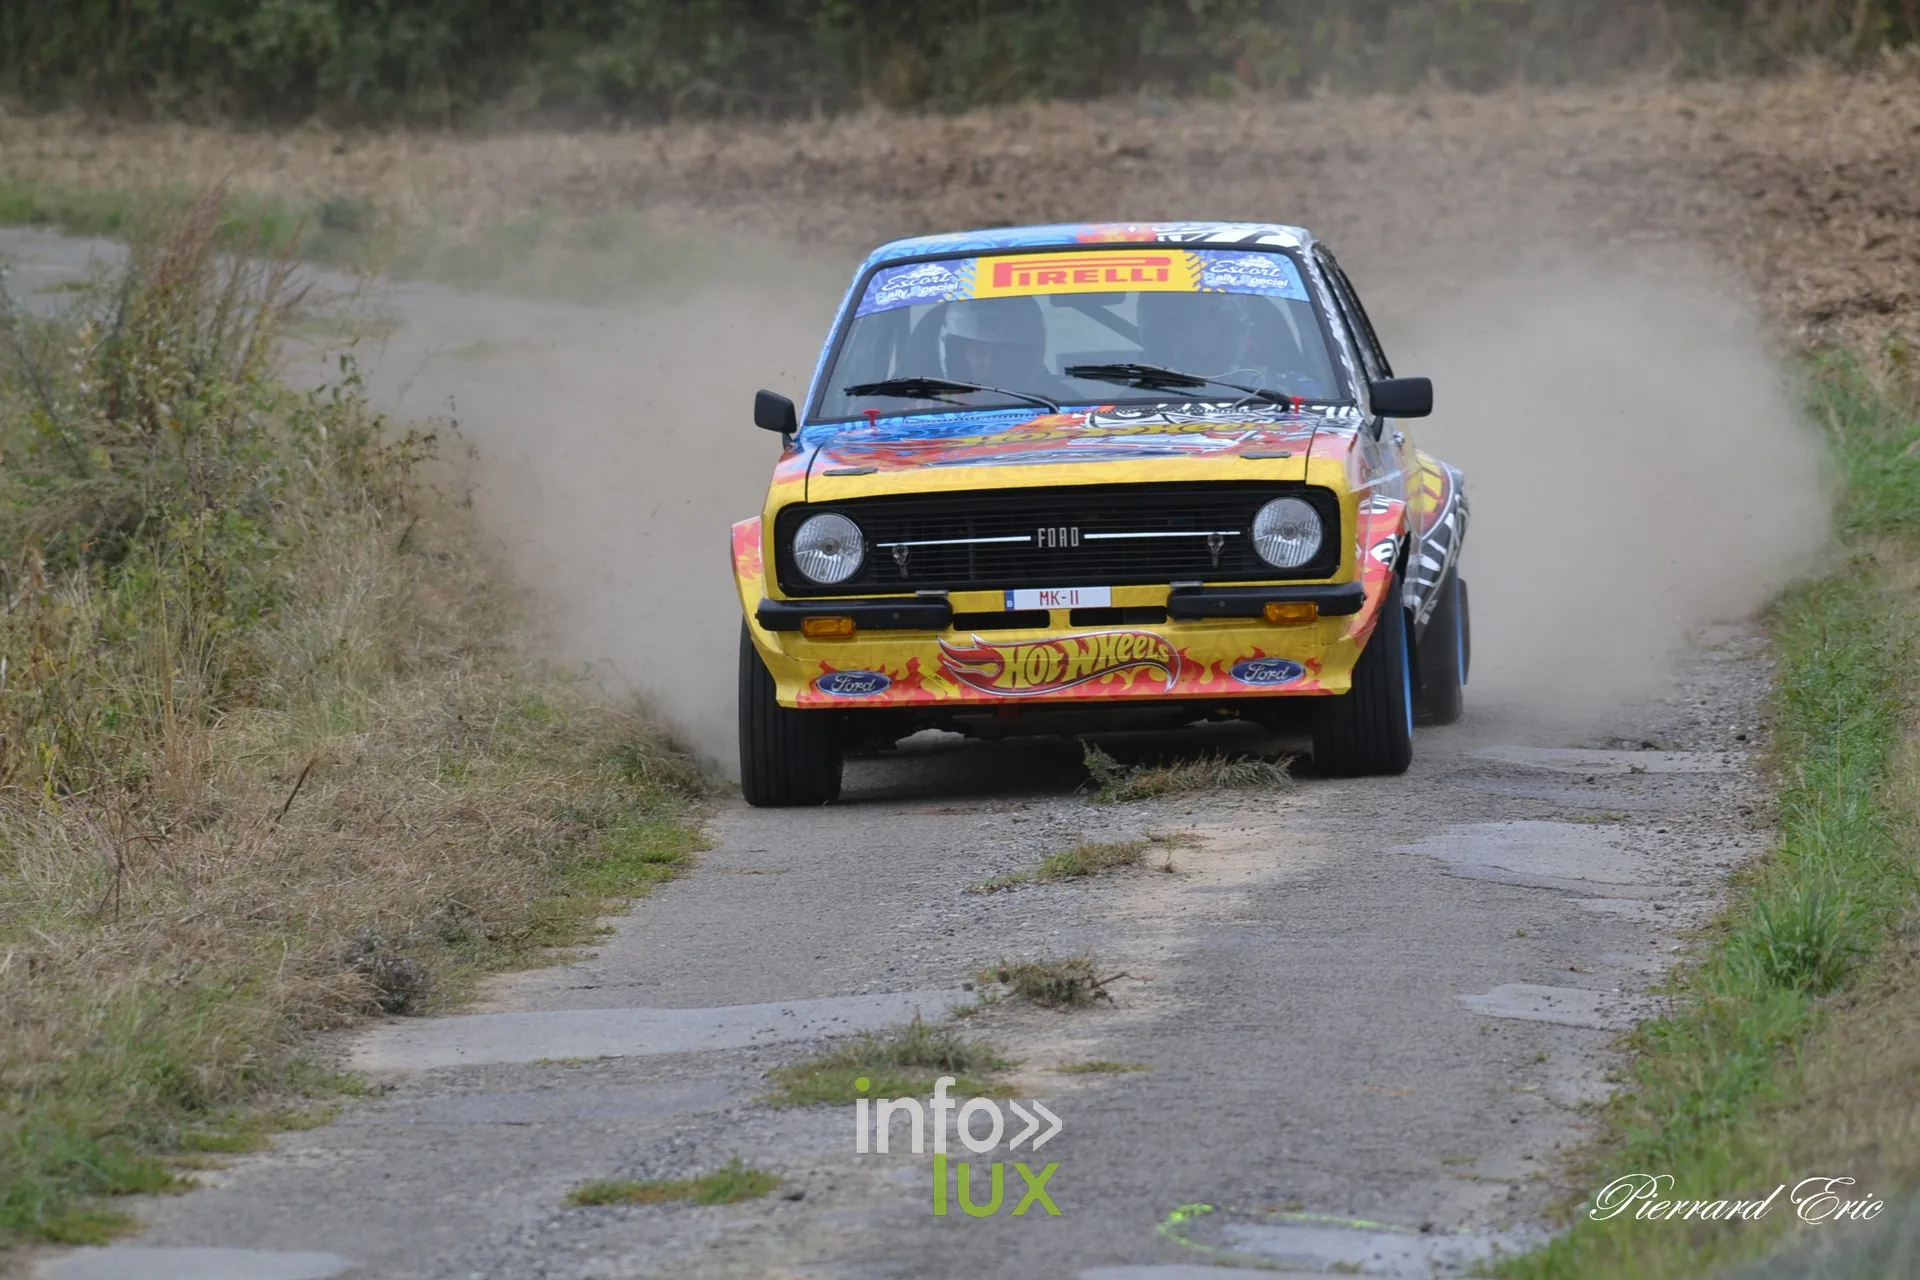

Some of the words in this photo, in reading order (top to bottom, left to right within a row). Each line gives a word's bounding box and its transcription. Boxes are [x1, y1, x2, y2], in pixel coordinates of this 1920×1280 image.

[993, 257, 1172, 288] PIRELLI
[1210, 260, 1281, 277] Escort
[881, 273, 953, 291] Escort
[1038, 527, 1079, 548] FORD
[1006, 600, 1013, 608] B
[1040, 590, 1079, 606] MK-II
[1244, 662, 1290, 681] Ford
[831, 674, 877, 692] Ford
